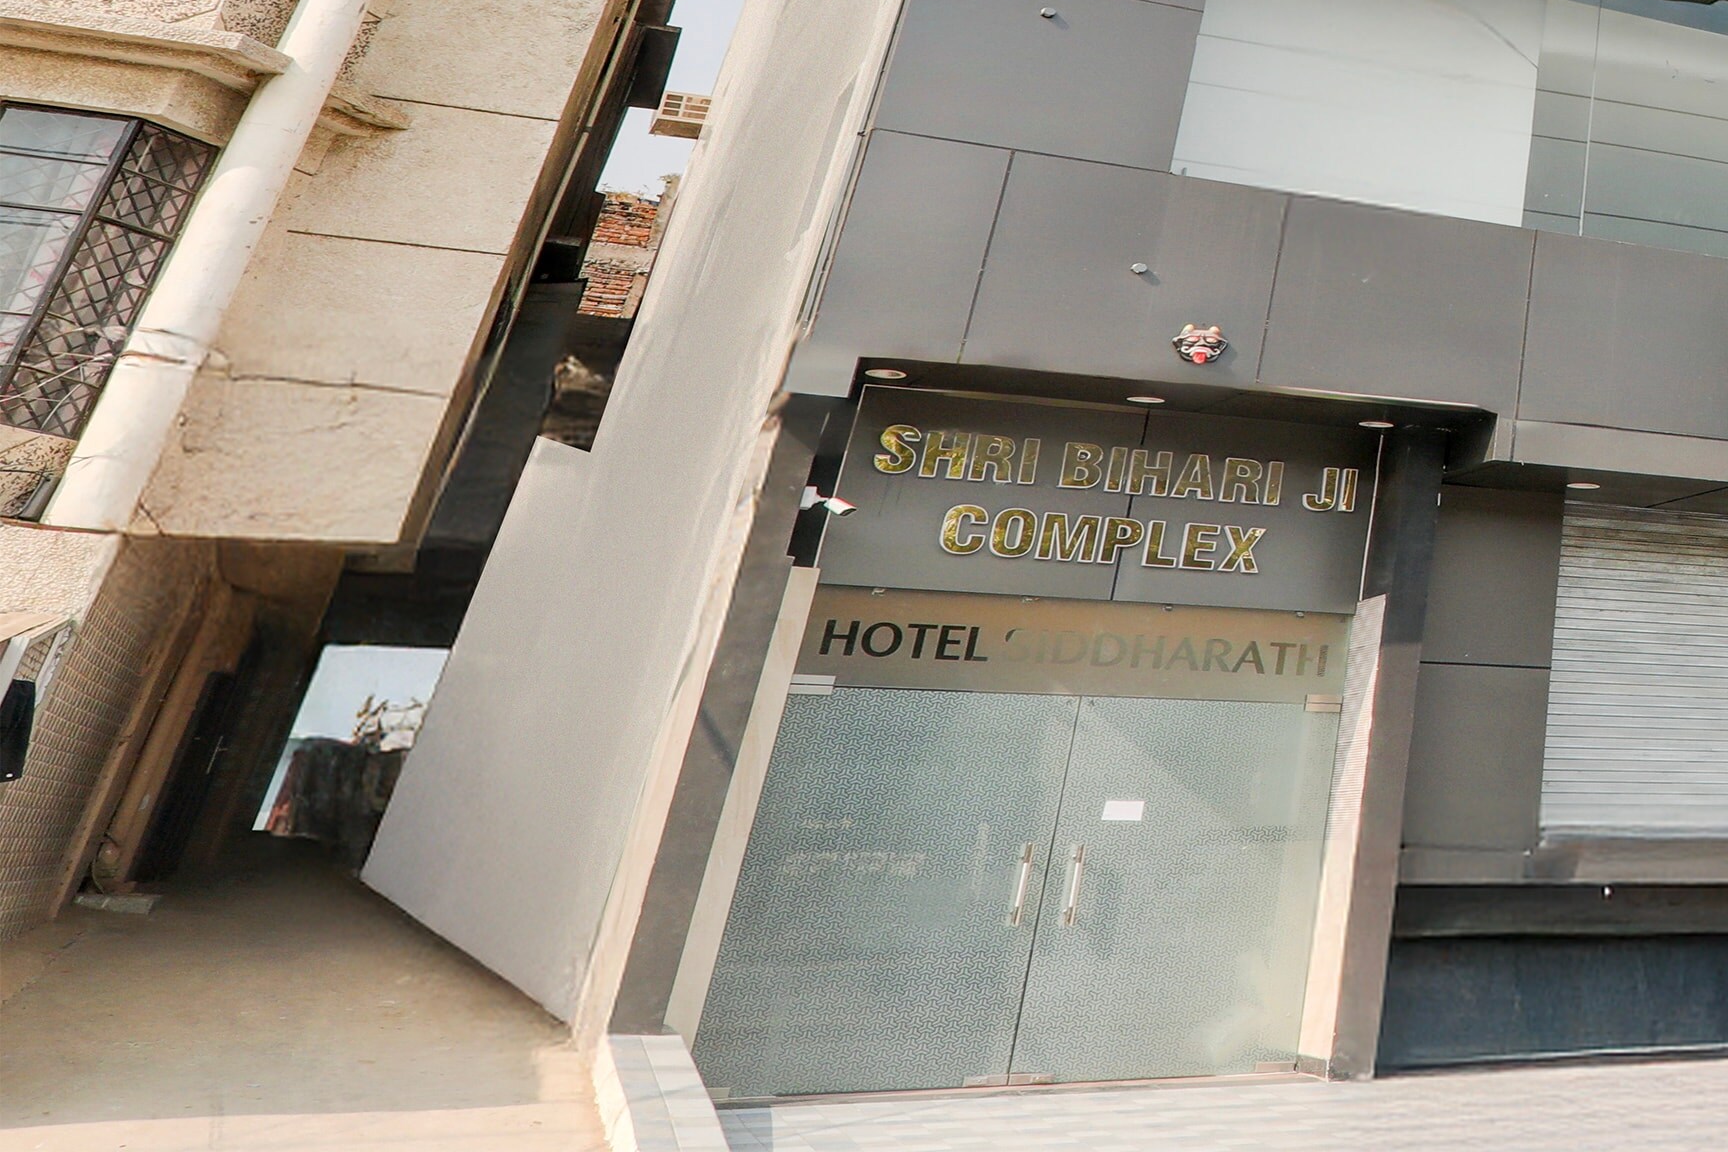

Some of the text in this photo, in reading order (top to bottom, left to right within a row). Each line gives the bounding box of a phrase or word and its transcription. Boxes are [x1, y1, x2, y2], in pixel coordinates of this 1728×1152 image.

[873, 424, 1359, 512] SHRI BIHARI JI
[938, 503, 1266, 573] COMPLEX
[819, 619, 1329, 677] HOTEL SIDDHARATH
